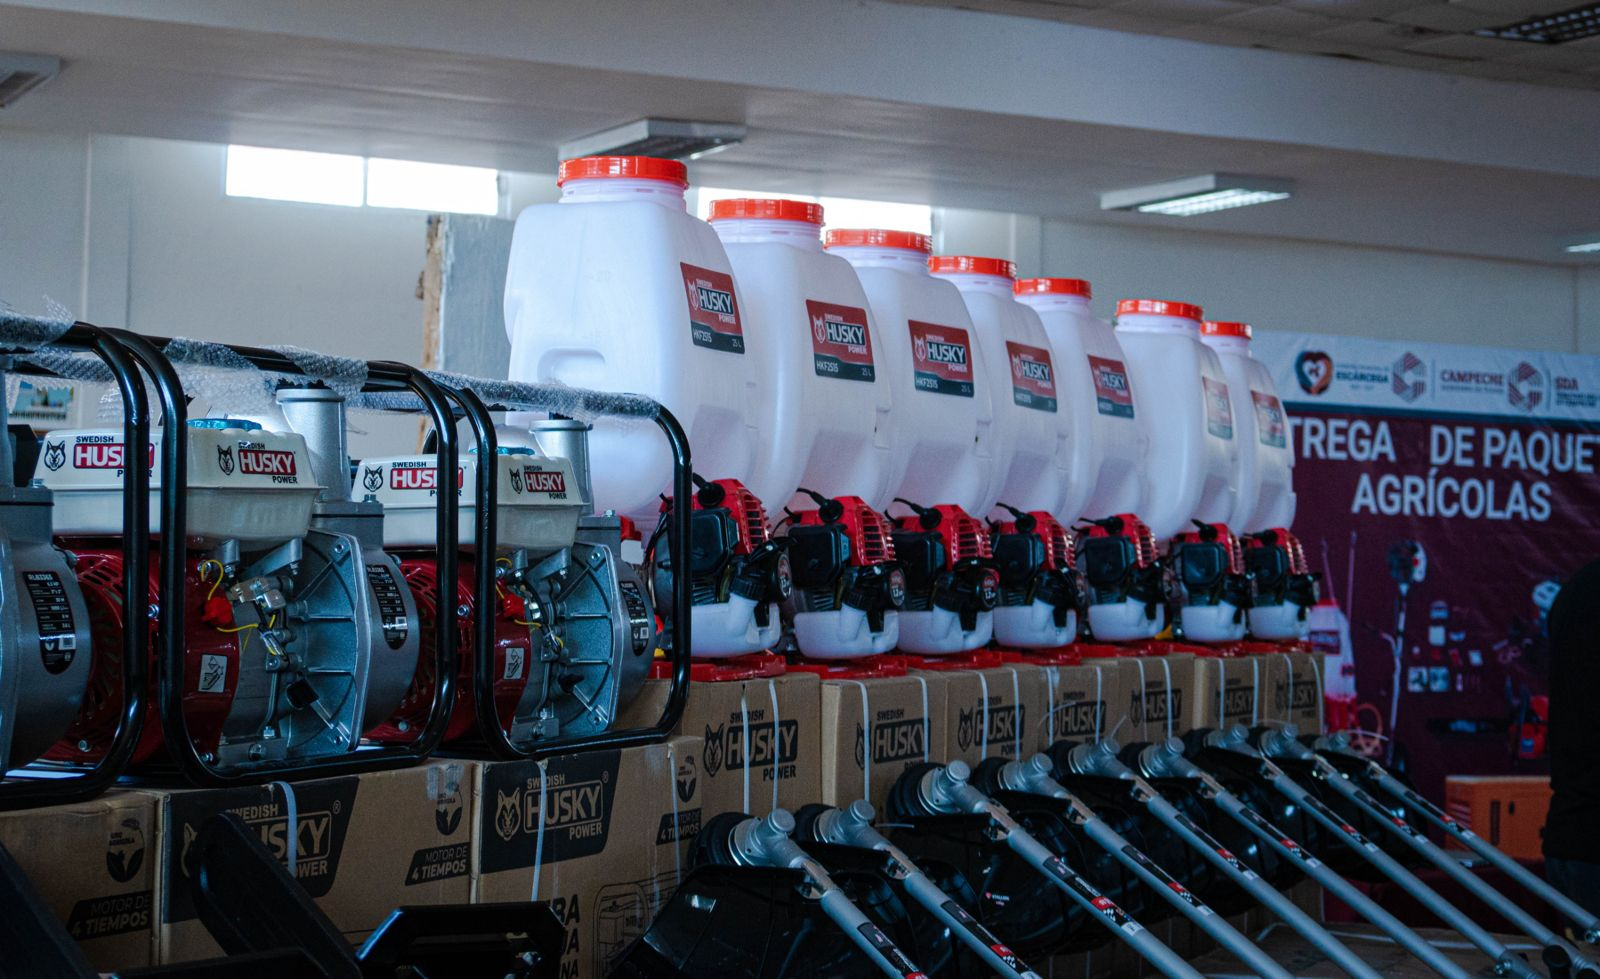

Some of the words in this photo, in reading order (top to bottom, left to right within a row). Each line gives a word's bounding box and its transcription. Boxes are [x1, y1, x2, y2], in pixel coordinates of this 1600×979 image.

[699, 288, 733, 313] HUSKY
[826, 322, 864, 345] HUSKY
[927, 342, 965, 363] HUSKY
[1022, 361, 1050, 381] HUSKY
[1288, 415, 1396, 462] TREGA
[1430, 424, 1475, 467] DE
[240, 452, 293, 473] HUSKY
[272, 475, 298, 484] POWER
[525, 473, 562, 491] HUSKY
[1351, 466, 1552, 522] AGRÍCOLAS
[730, 710, 764, 723] SWDISH
[527, 773, 566, 789] SWDISH
[526, 784, 600, 827] HUSKY
[569, 822, 602, 840] POWER
[425, 848, 454, 864] MOTOR
[455, 845, 468, 858] DE
[412, 867, 419, 880] 4
[421, 859, 466, 880] TIEMPOS
[71, 921, 81, 937] 4
[85, 910, 148, 935] TIEMPOS
